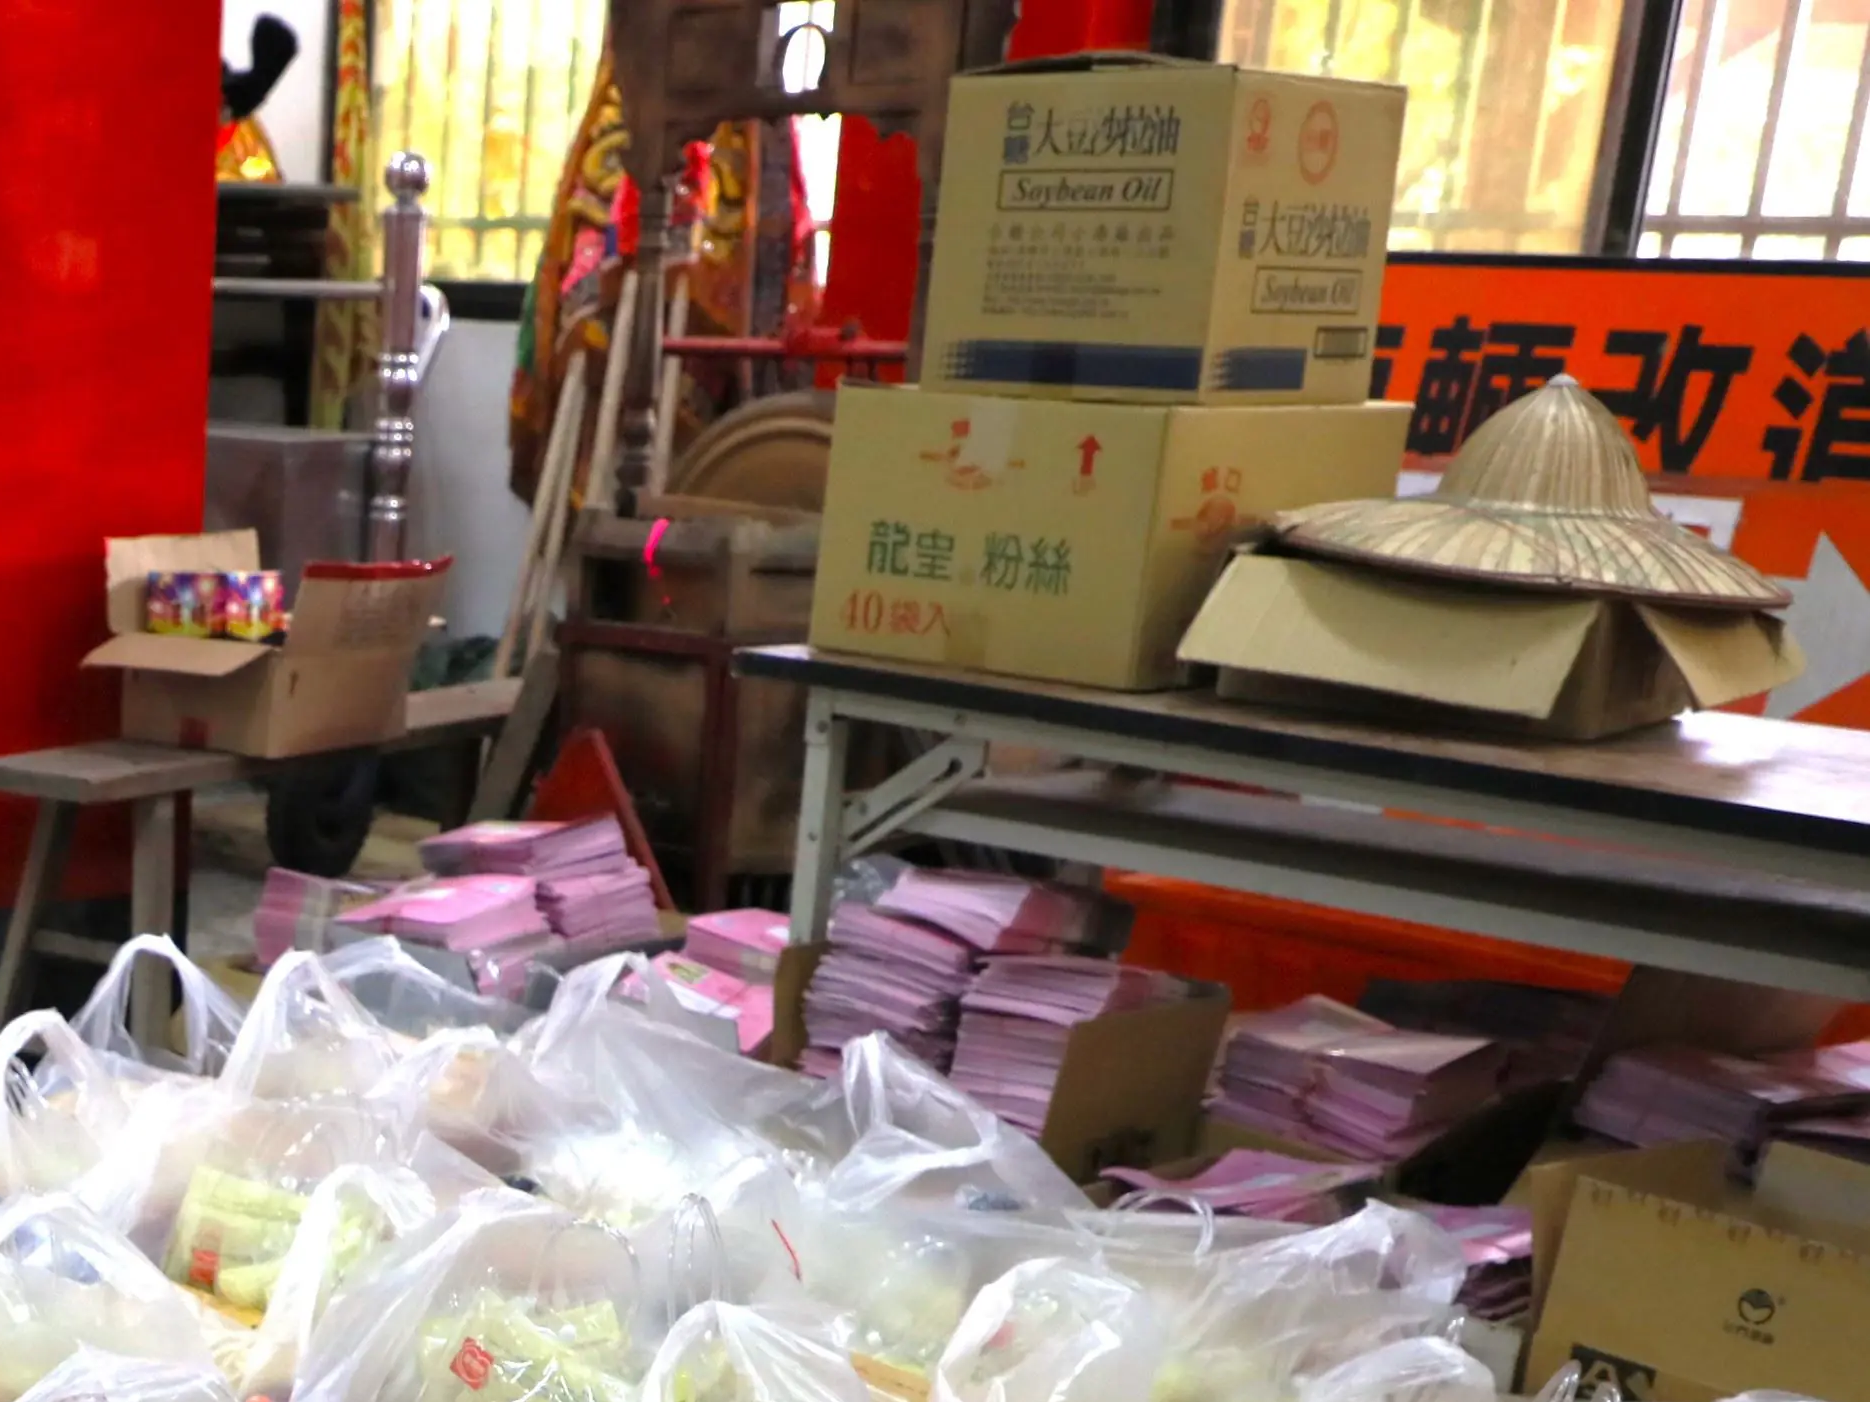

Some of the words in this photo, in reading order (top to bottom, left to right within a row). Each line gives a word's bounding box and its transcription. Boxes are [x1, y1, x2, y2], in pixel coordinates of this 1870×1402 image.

[1011, 177, 1113, 209] Soybean
[1123, 176, 1163, 202] Oil
[1261, 272, 1329, 309] Soybean
[1331, 278, 1356, 304] Oil
[1370, 315, 1870, 482] 輛改道
[979, 531, 1073, 597] 粉絲
